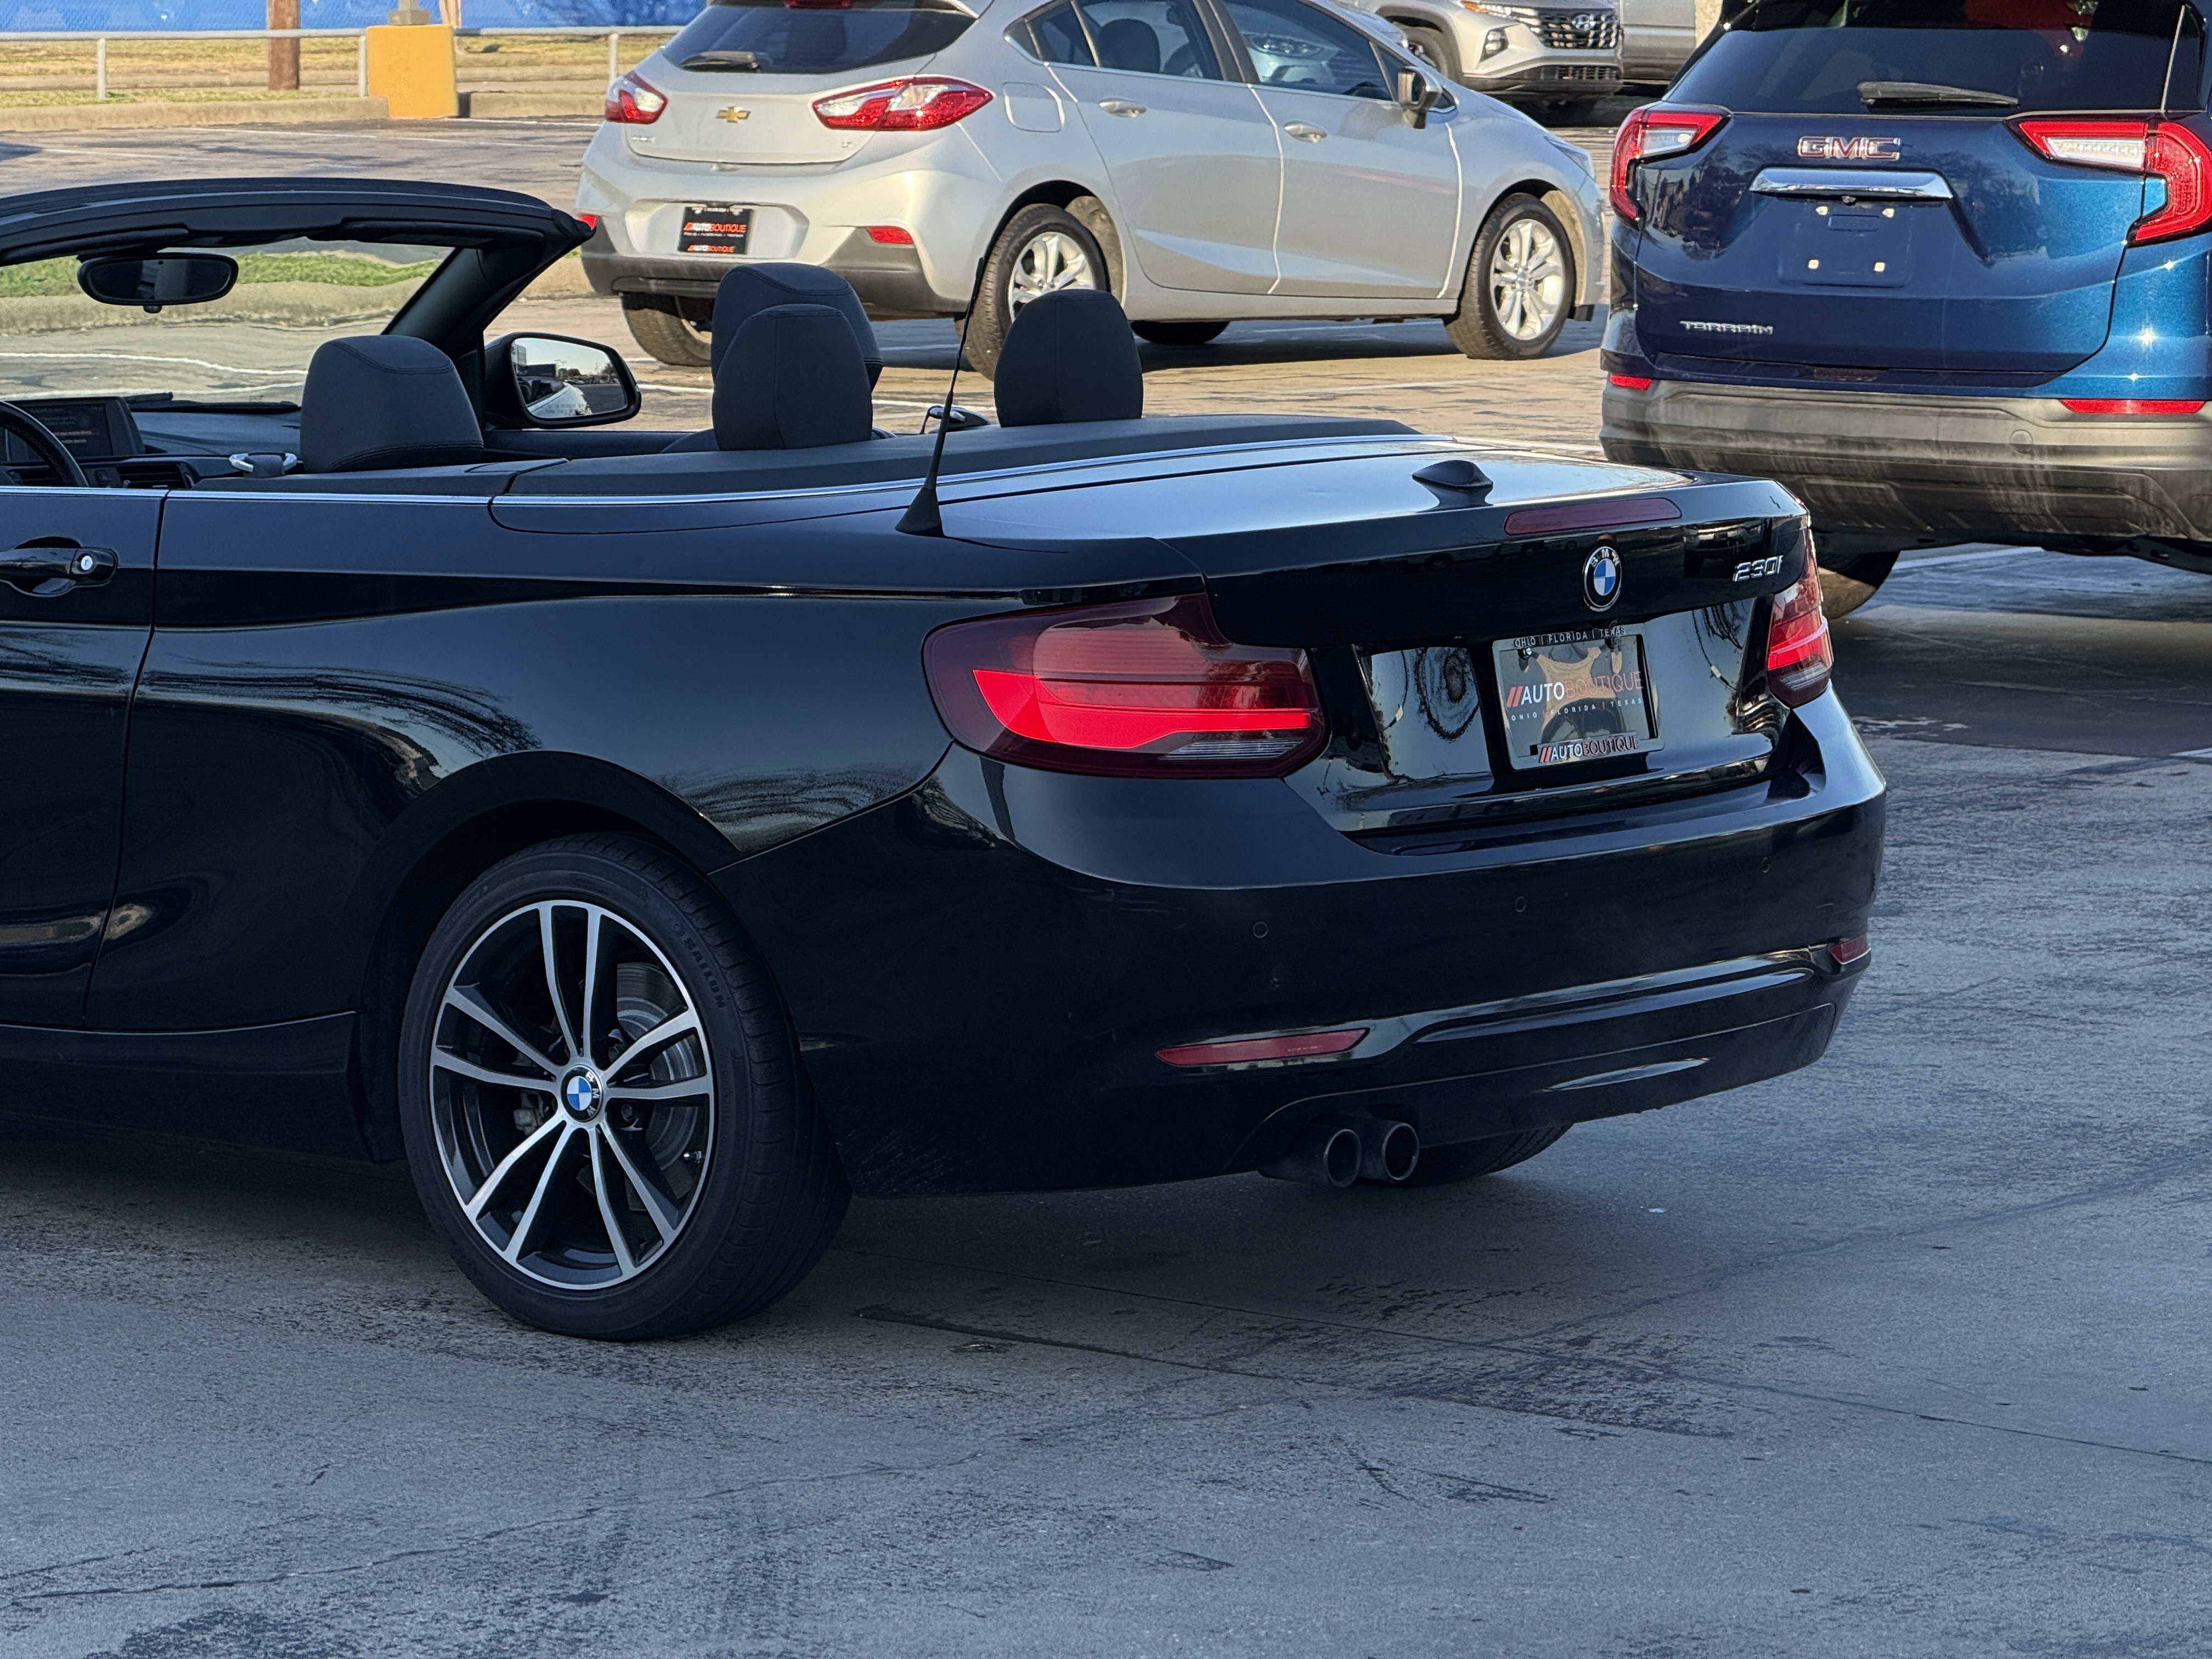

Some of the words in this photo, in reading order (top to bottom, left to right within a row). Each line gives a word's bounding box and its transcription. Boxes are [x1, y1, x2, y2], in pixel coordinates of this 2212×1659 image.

[1797, 136, 1901, 160] GMC
[1679, 321, 1773, 335] TERRAIN
[1590, 549, 1620, 567] BMW
[1514, 636, 1536, 648] OHIO
[1548, 631, 1588, 644] FLORIDA
[1600, 627, 1626, 637] TEXAS
[1511, 712, 1537, 721] OHIO
[1551, 704, 1596, 716] FLORIDA
[1610, 697, 1643, 707] TEXAS
[684, 937, 727, 1008] SAILUN
[585, 1071, 600, 1118] BMW
